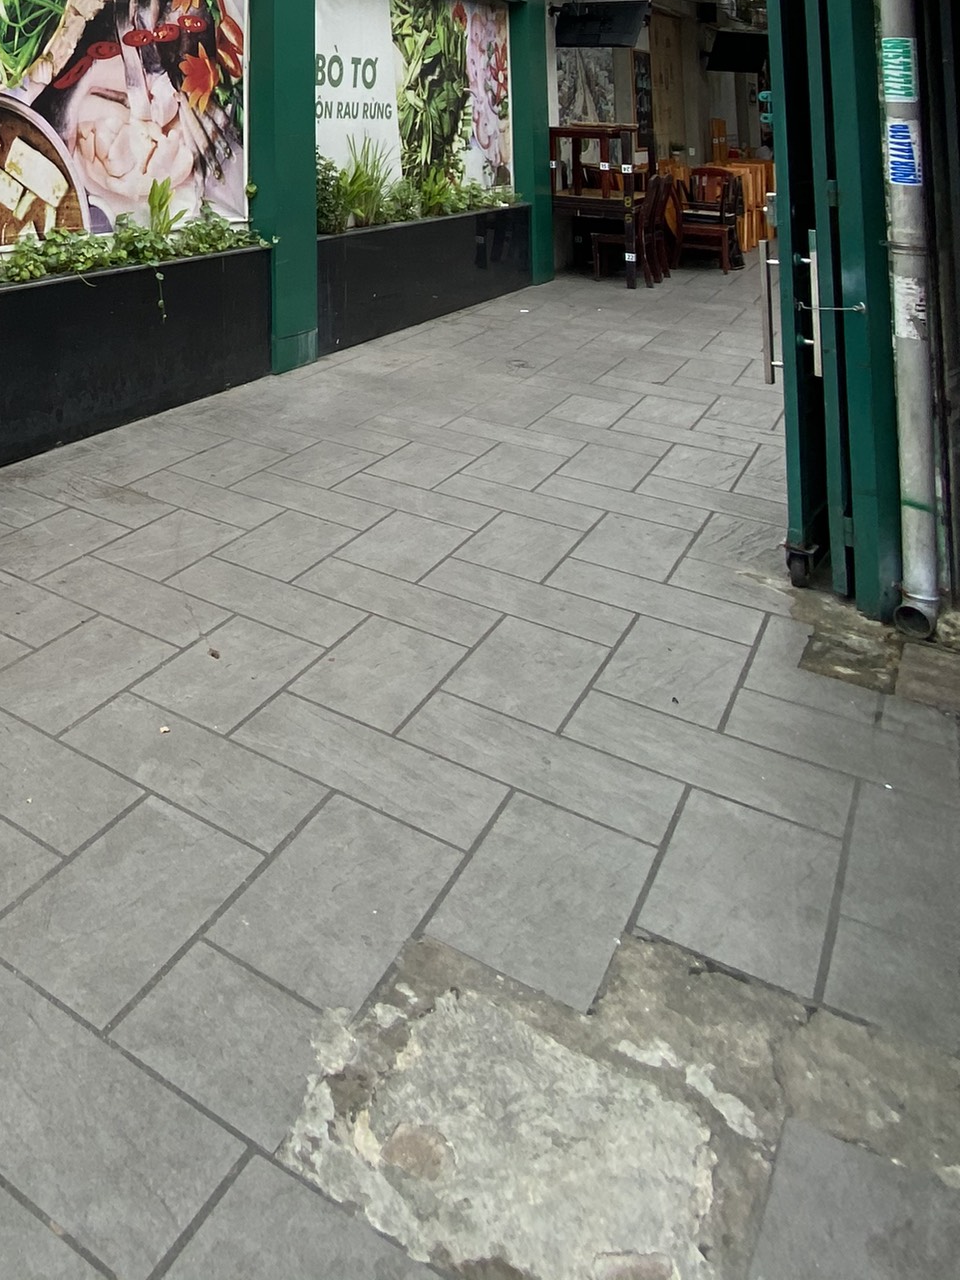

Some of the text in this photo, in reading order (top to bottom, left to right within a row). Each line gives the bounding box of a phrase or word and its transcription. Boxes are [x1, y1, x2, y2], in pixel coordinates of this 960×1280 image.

[315, 44, 379, 90] BÒ TƠ
[336, 101, 360, 120] RAU
[362, 97, 393, 120] RỪNG
